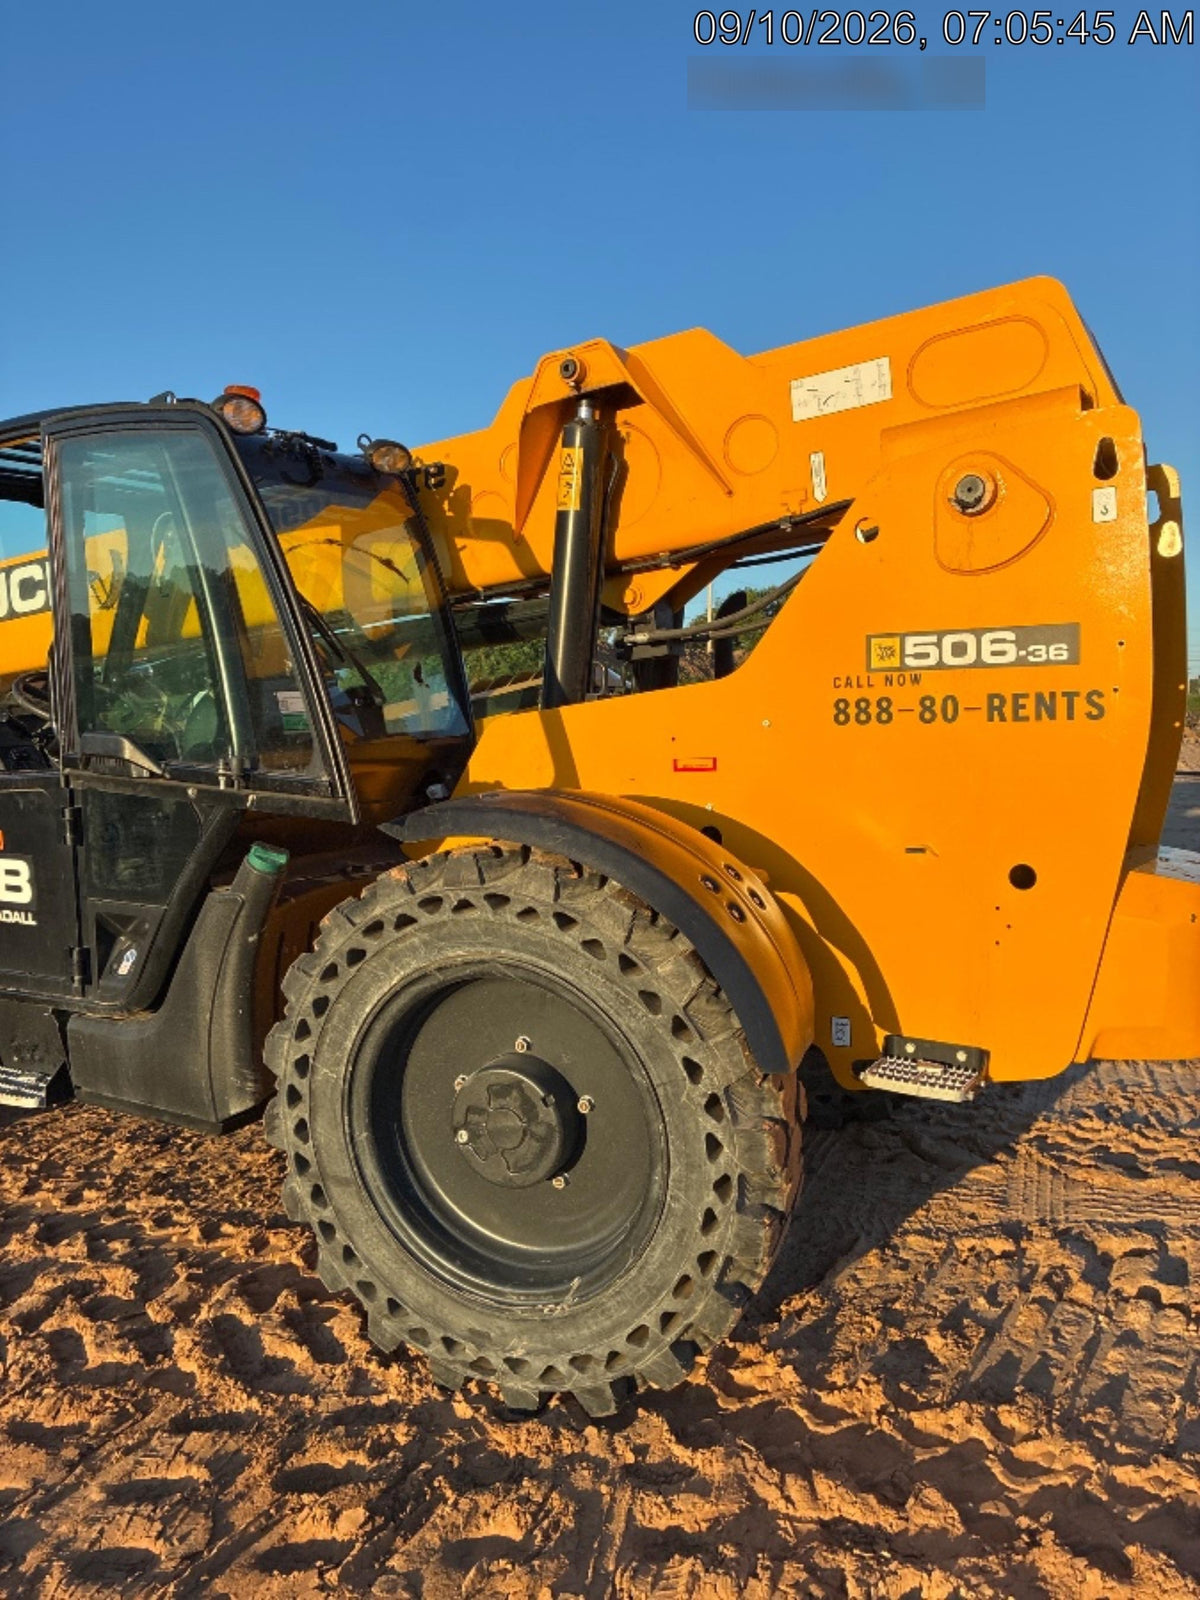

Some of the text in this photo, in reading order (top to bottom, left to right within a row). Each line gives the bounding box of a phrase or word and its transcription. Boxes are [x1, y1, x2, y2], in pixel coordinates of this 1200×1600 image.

[833, 673, 923, 689] CALL NOW
[832, 689, 1106, 726] 888-80-RENTS
[0, 909, 38, 926] DALL
